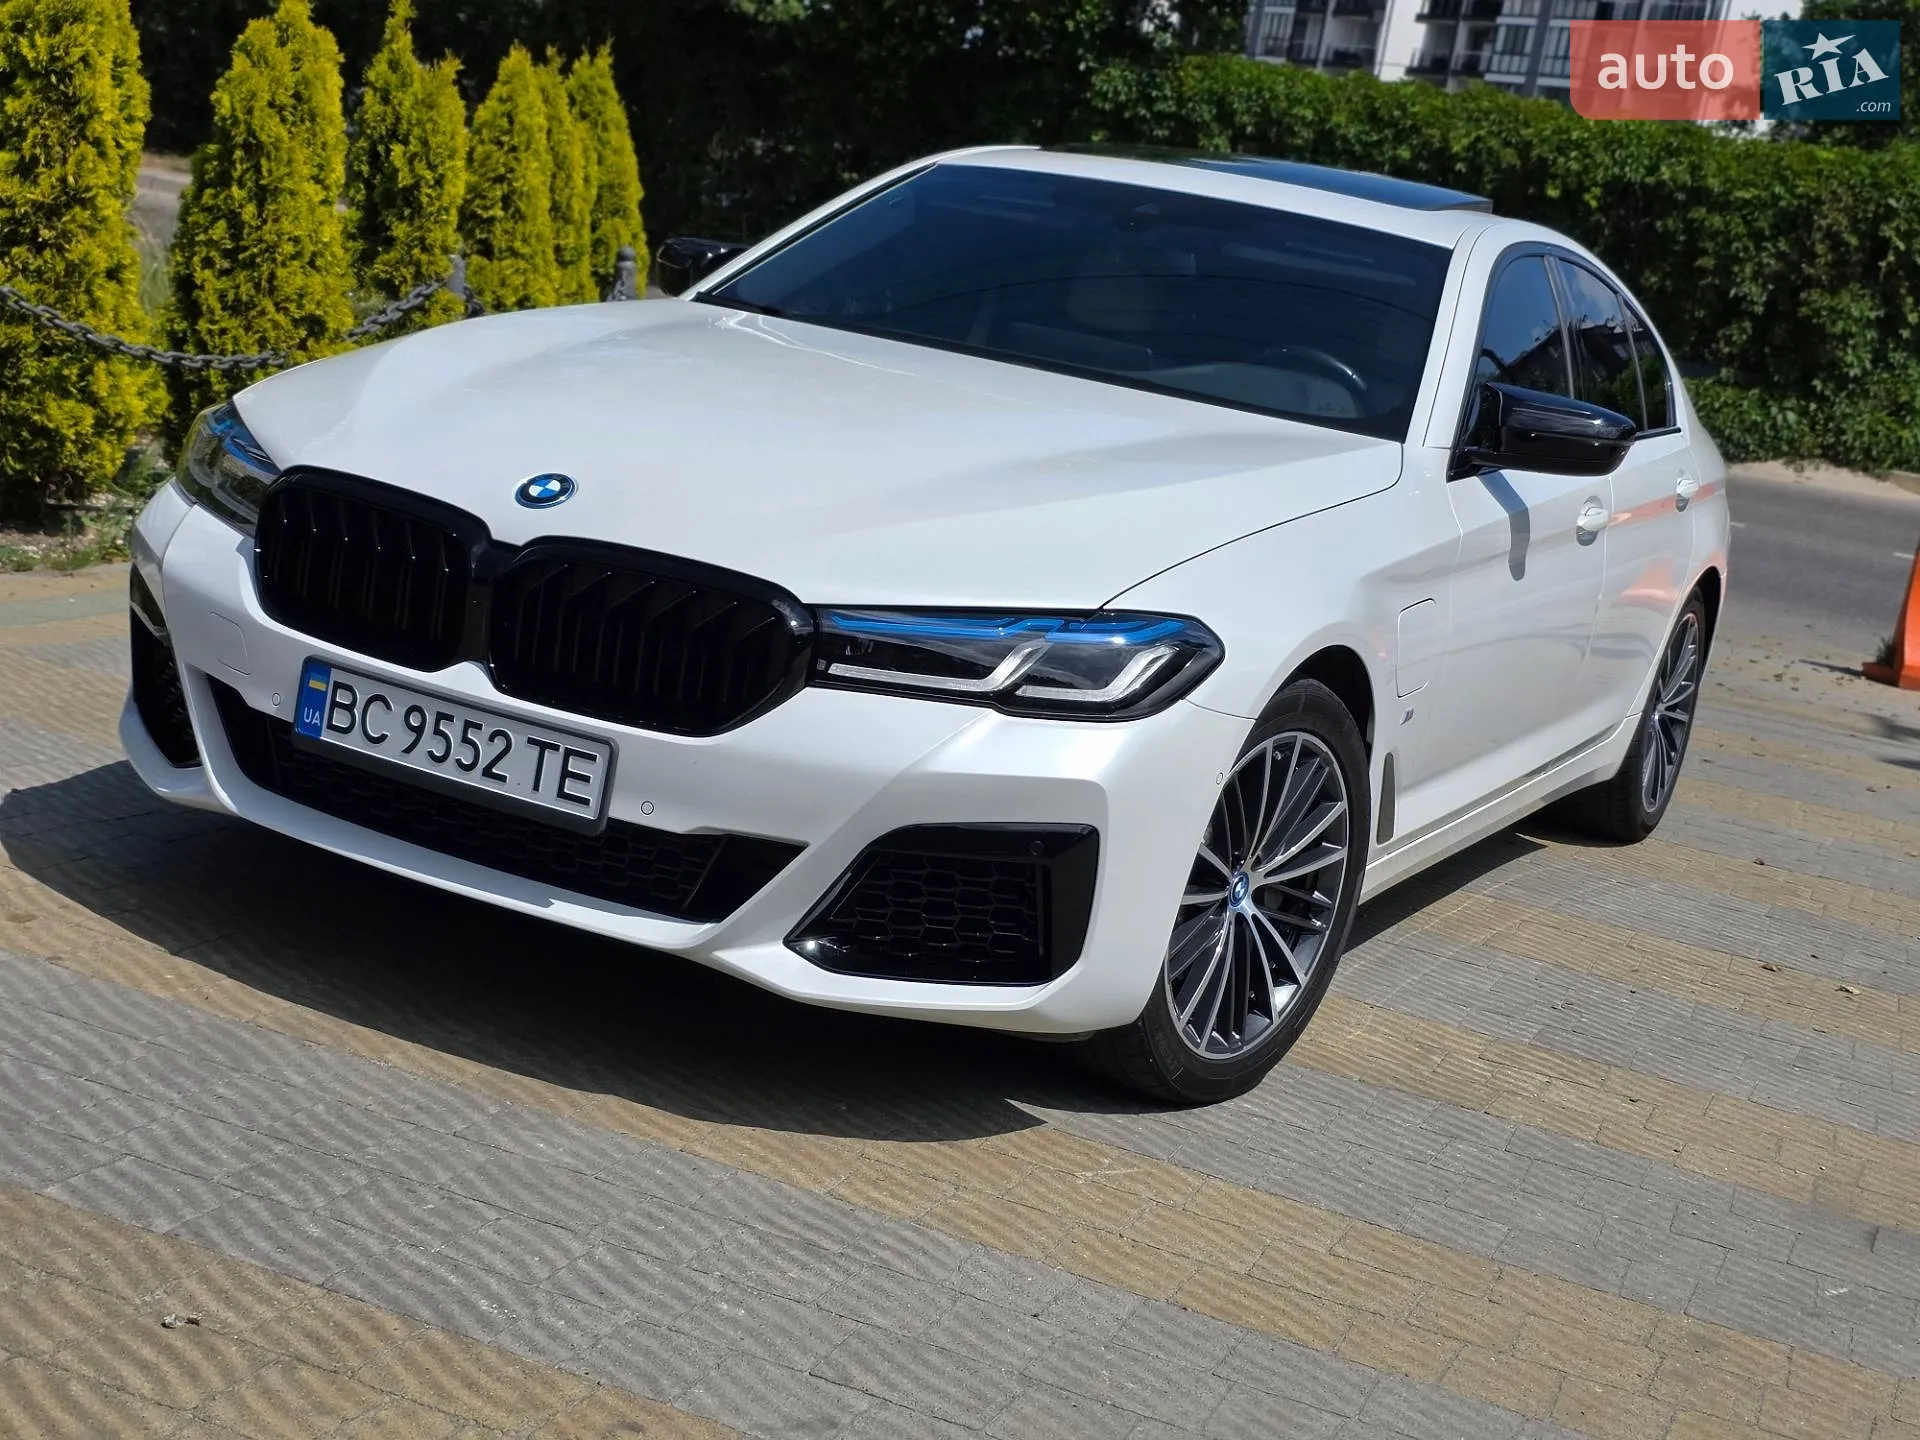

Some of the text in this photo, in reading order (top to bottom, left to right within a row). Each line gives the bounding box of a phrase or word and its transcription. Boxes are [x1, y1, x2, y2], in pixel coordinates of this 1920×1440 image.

[303, 706, 321, 727] UA
[326, 680, 598, 806] BC 9552 TE
